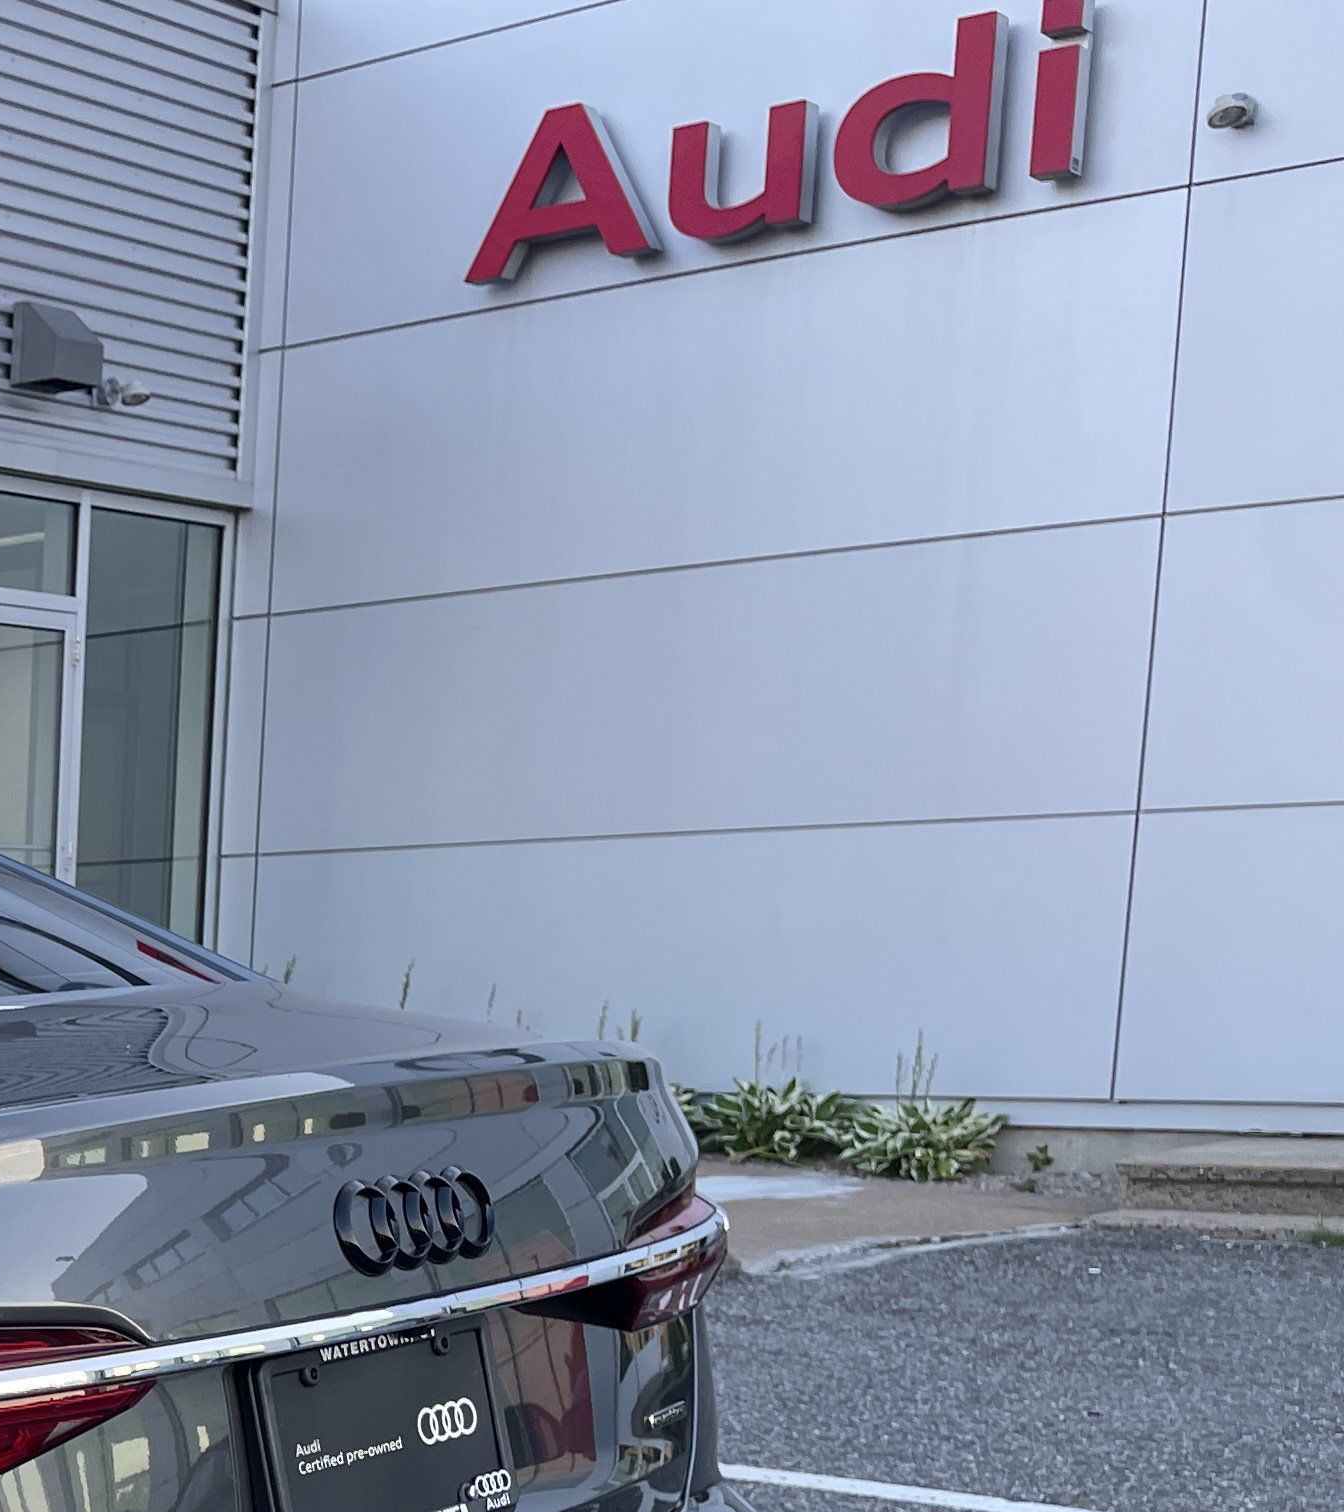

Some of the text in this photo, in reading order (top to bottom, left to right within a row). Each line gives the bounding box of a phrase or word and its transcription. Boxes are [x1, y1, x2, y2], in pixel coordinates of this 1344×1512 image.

[464, 0, 1098, 286] Audi
[295, 1438, 322, 1458] Audi
[298, 1436, 404, 1475] Certified pre-owned
[486, 1491, 511, 1511] Audi
